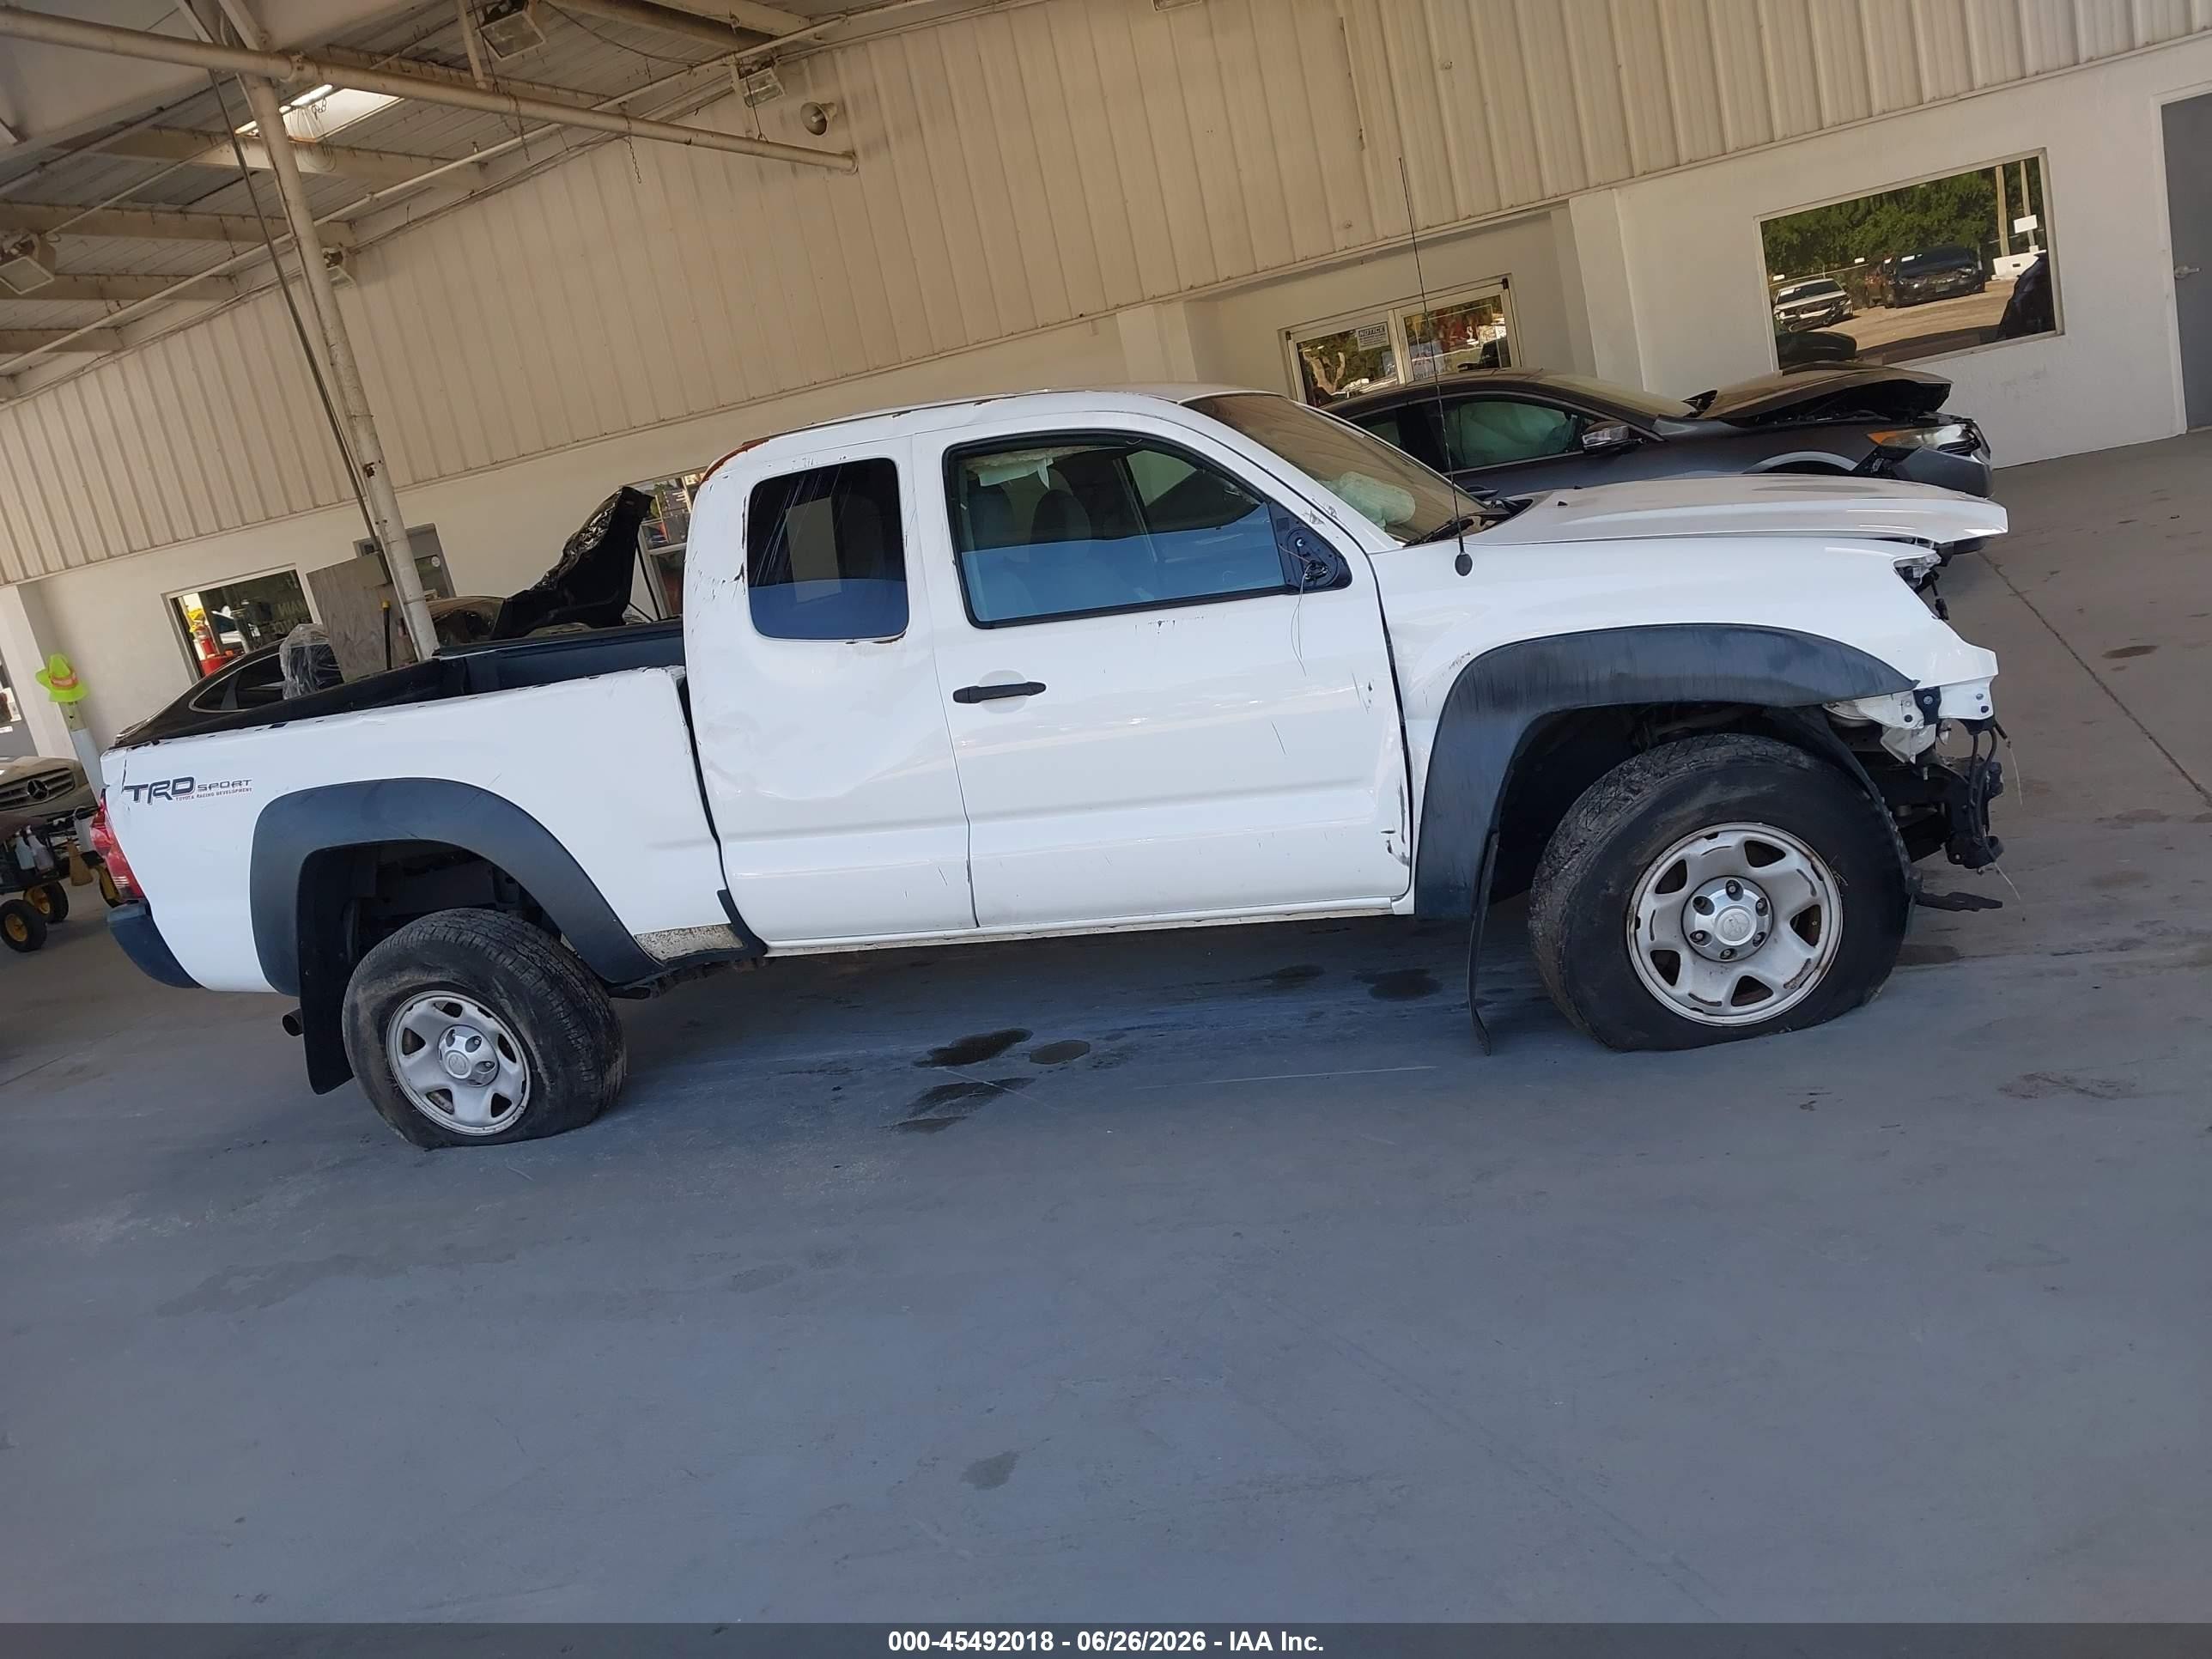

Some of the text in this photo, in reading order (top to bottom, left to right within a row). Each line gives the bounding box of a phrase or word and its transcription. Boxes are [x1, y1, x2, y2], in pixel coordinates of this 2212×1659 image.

[1359, 325, 1386, 337] NOTICE
[124, 776, 252, 805] TRD SPORT
[216, 787, 252, 796] DEVELOPMENT
